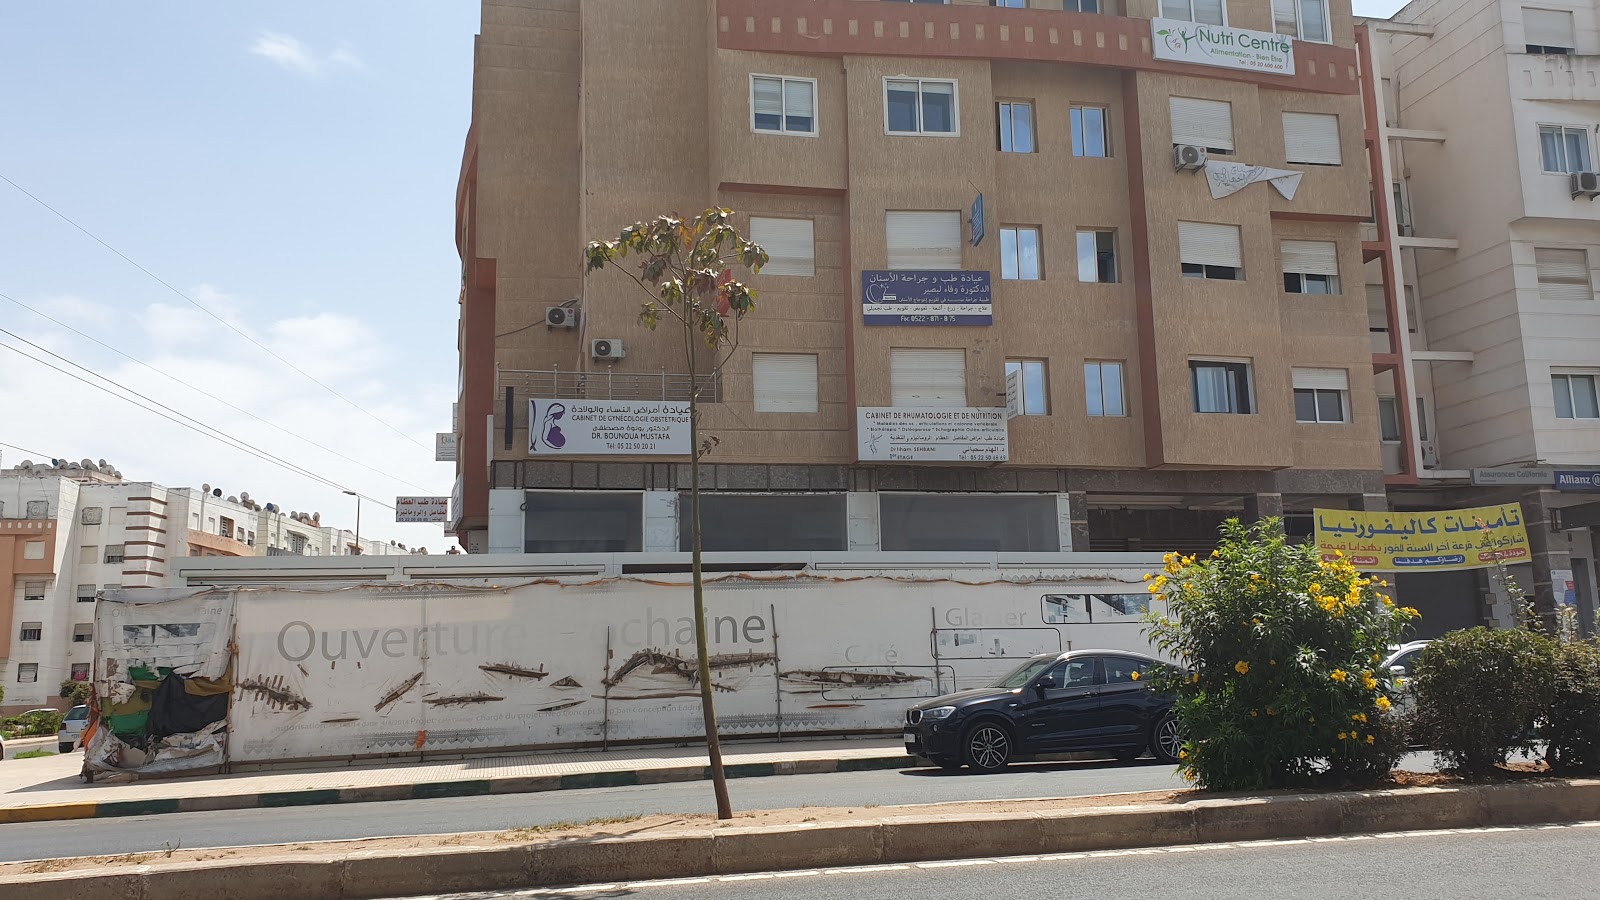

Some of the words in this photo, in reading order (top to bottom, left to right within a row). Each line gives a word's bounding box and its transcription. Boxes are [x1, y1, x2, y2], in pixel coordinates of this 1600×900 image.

[1199, 29, 1233, 46] Nutri
[1238, 34, 1290, 53] Centre
[1210, 48, 1251, 59] Alimentation
[869, 272, 898, 283] الأسنان
[901, 273, 928, 283] جراحة
[940, 273, 958, 285] طب
[961, 273, 983, 284] عيادة
[944, 285, 958, 294] وفاء
[961, 284, 990, 295] الدكتورة
[571, 404, 604, 414] والولادة
[606, 406, 631, 414] النساء
[633, 404, 660, 415] أمراض
[662, 404, 691, 416] عيادة
[607, 414, 649, 422] GYNÉCOLOGIE
[650, 415, 689, 424] OBSTÉTRIQUE
[971, 412, 1002, 420] NUTRITION
[1559, 474, 1591, 484] Allianz
[417, 498, 429, 507] طب
[1319, 514, 1438, 539] كاليفورنيا
[1406, 542, 1434, 552] السنة
[1452, 541, 1473, 552] قرعة
[945, 607, 1026, 627] Glacer
[845, 643, 898, 664] Cfé
